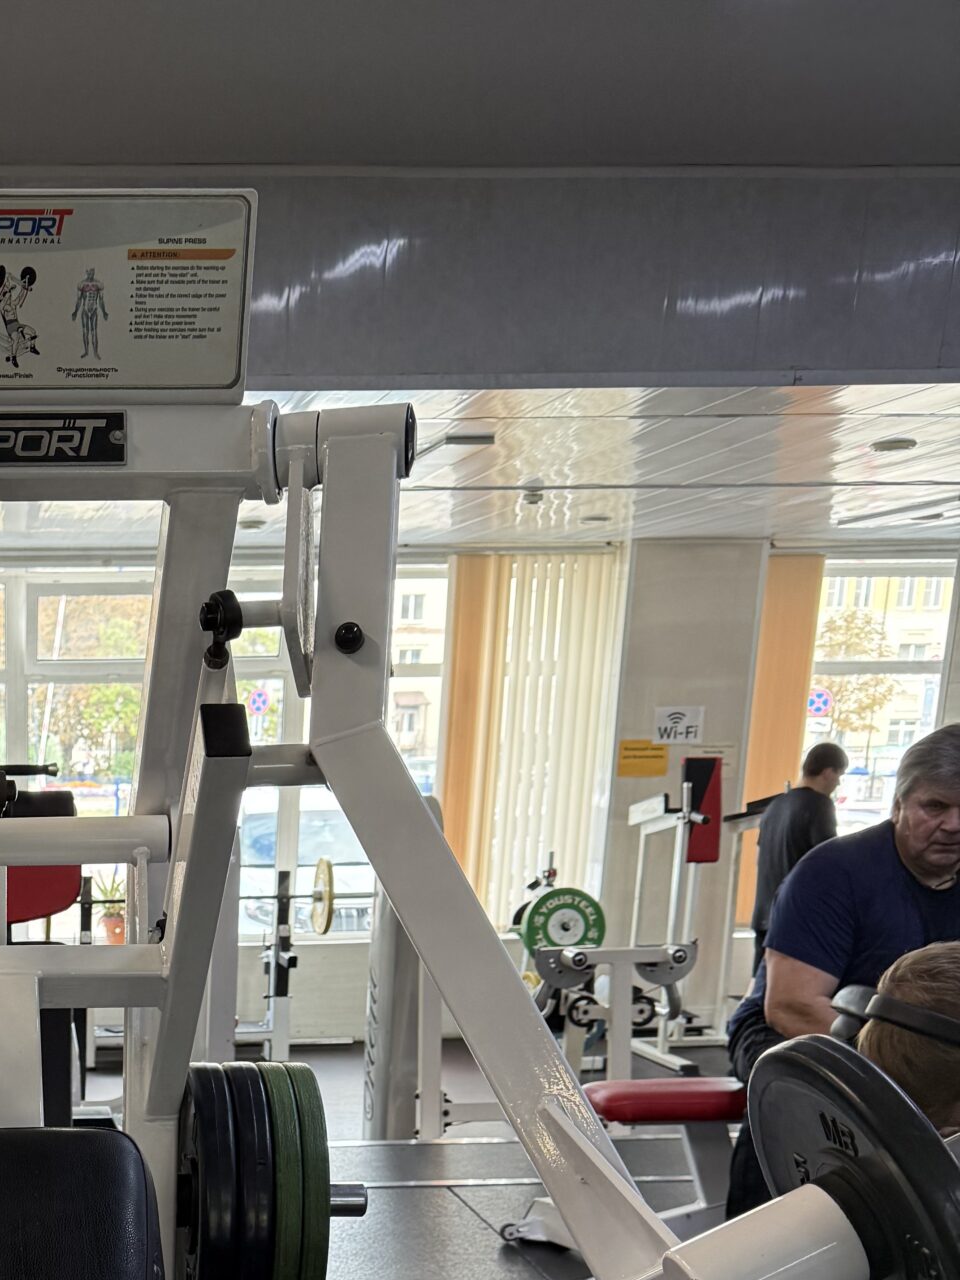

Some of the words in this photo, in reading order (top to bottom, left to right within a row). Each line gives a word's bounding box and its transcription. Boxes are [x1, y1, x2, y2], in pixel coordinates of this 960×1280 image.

[158, 237, 183, 245] SUPINE
[184, 237, 207, 245] PRESS
[56, 366, 119, 375] Функциональность
[658, 724, 699, 740] Wi-Fi
